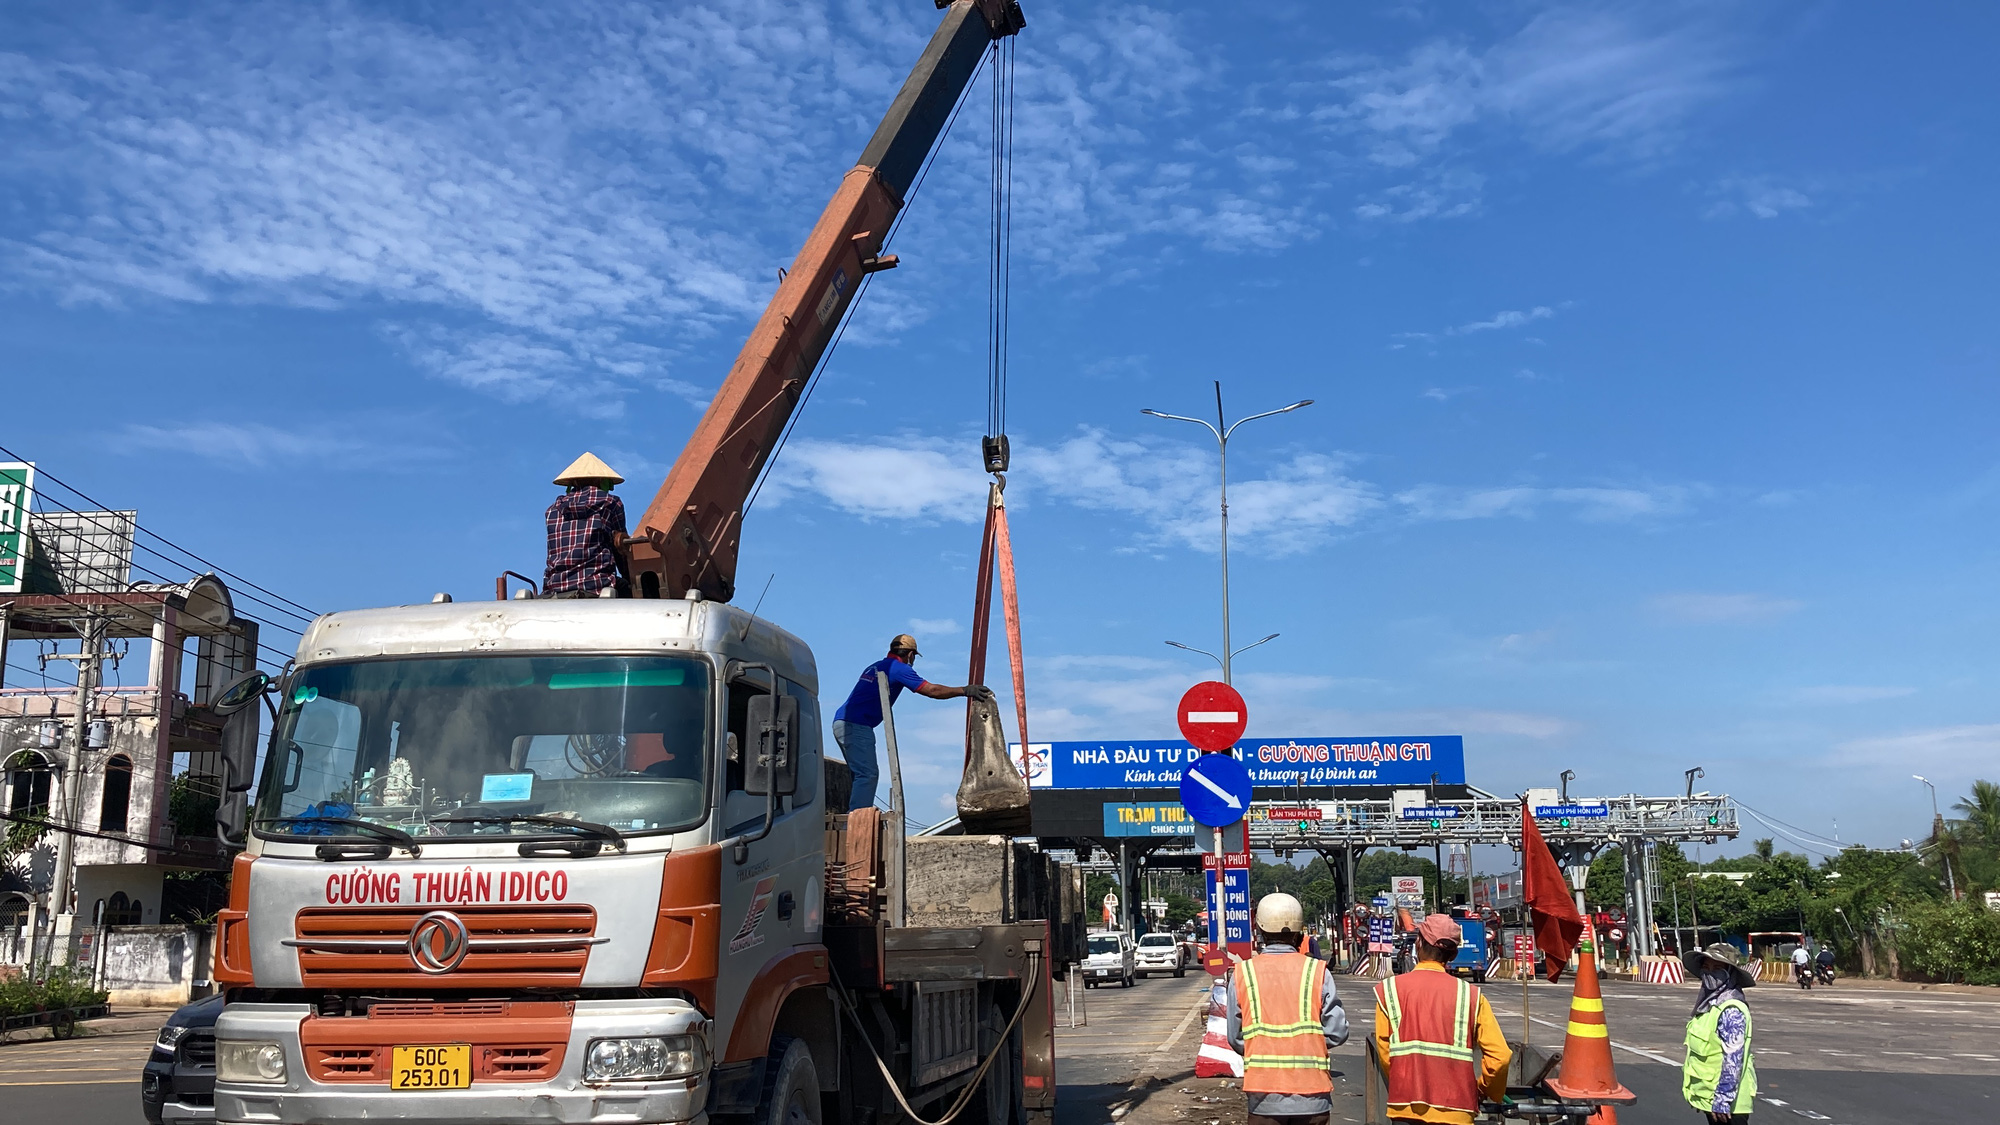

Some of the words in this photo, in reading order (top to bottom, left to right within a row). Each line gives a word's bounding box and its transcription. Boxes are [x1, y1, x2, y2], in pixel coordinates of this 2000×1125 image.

[1073, 746, 1110, 764] NHÀ
[1114, 745, 1150, 763] ĐẦU
[1155, 749, 1182, 763] TƯ
[1187, 749, 1202, 763] D
[1258, 741, 1330, 763] CƯỜNG
[1332, 742, 1398, 766] THUẬN
[1400, 743, 1431, 761] CTI
[1125, 770, 1155, 782] Kính
[1158, 770, 1182, 782] chú
[1259, 769, 1307, 783] thượng
[1310, 768, 1324, 782] lộ
[1325, 768, 1357, 780] bình
[1359, 770, 1378, 779] an
[1118, 807, 1156, 825] TRẠM
[1159, 807, 1185, 822] THU
[1151, 824, 1175, 834] CHÚC
[1205, 855, 1215, 866] QU
[1228, 852, 1248, 865] PHÚT
[326, 866, 400, 904] CƯỜNG
[412, 866, 491, 905] THUẬN
[499, 870, 568, 902] IDICO
[1224, 873, 1236, 887] ÀN
[1230, 890, 1245, 903] PHÍ
[415, 1048, 447, 1066] 60C
[400, 1068, 459, 1087] 253.01
